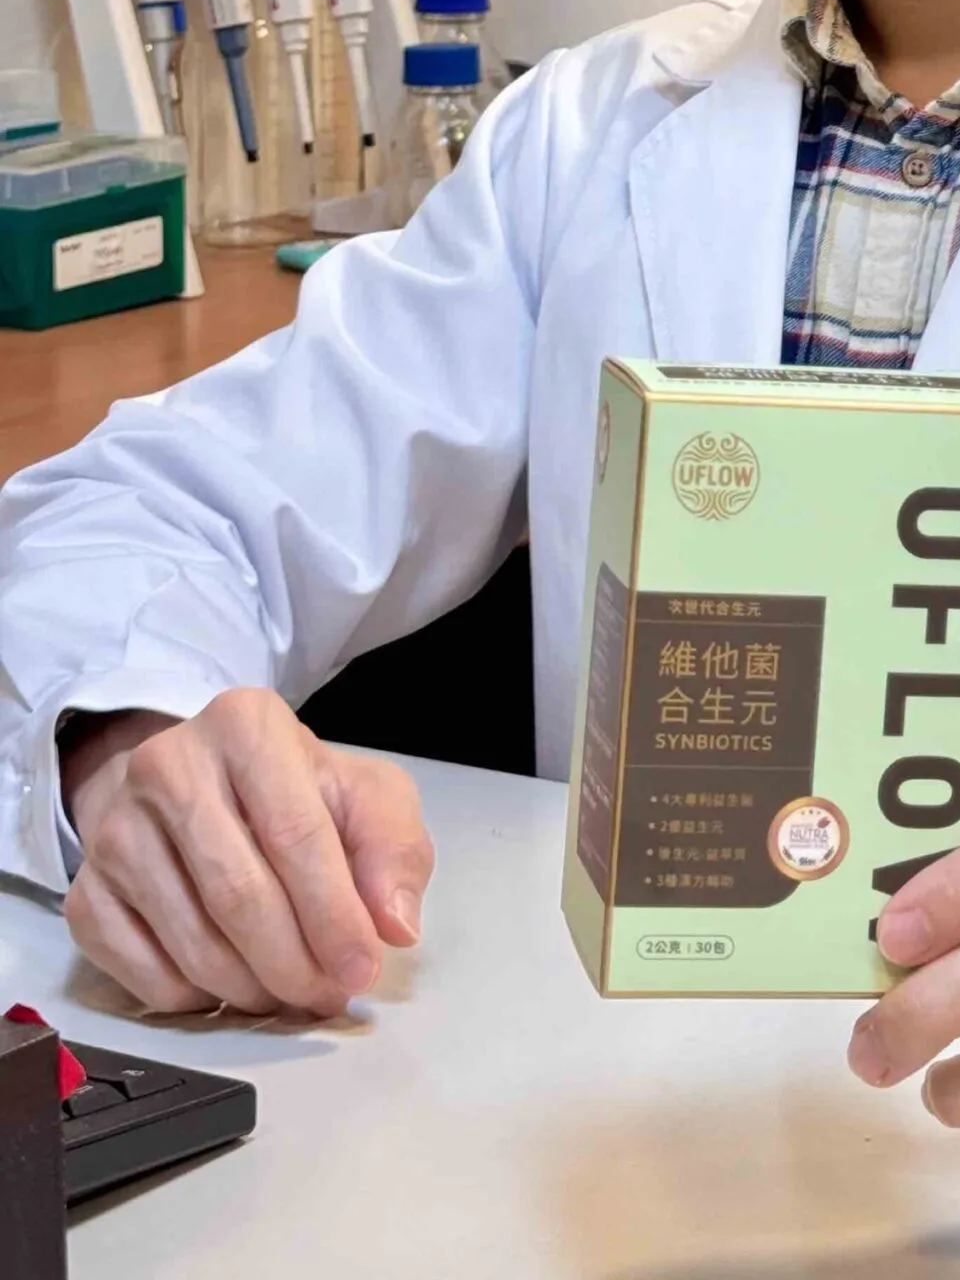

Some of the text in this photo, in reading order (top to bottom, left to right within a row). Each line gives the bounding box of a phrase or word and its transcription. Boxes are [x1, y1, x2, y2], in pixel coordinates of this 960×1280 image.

[679, 464, 754, 487] UFLOW
[668, 599, 762, 617] 次世代合生元
[658, 640, 782, 681] 維他菌
[657, 686, 778, 726] 合生元
[655, 732, 773, 751] SYNBIOTICS
[695, 941, 725, 954] 30包
